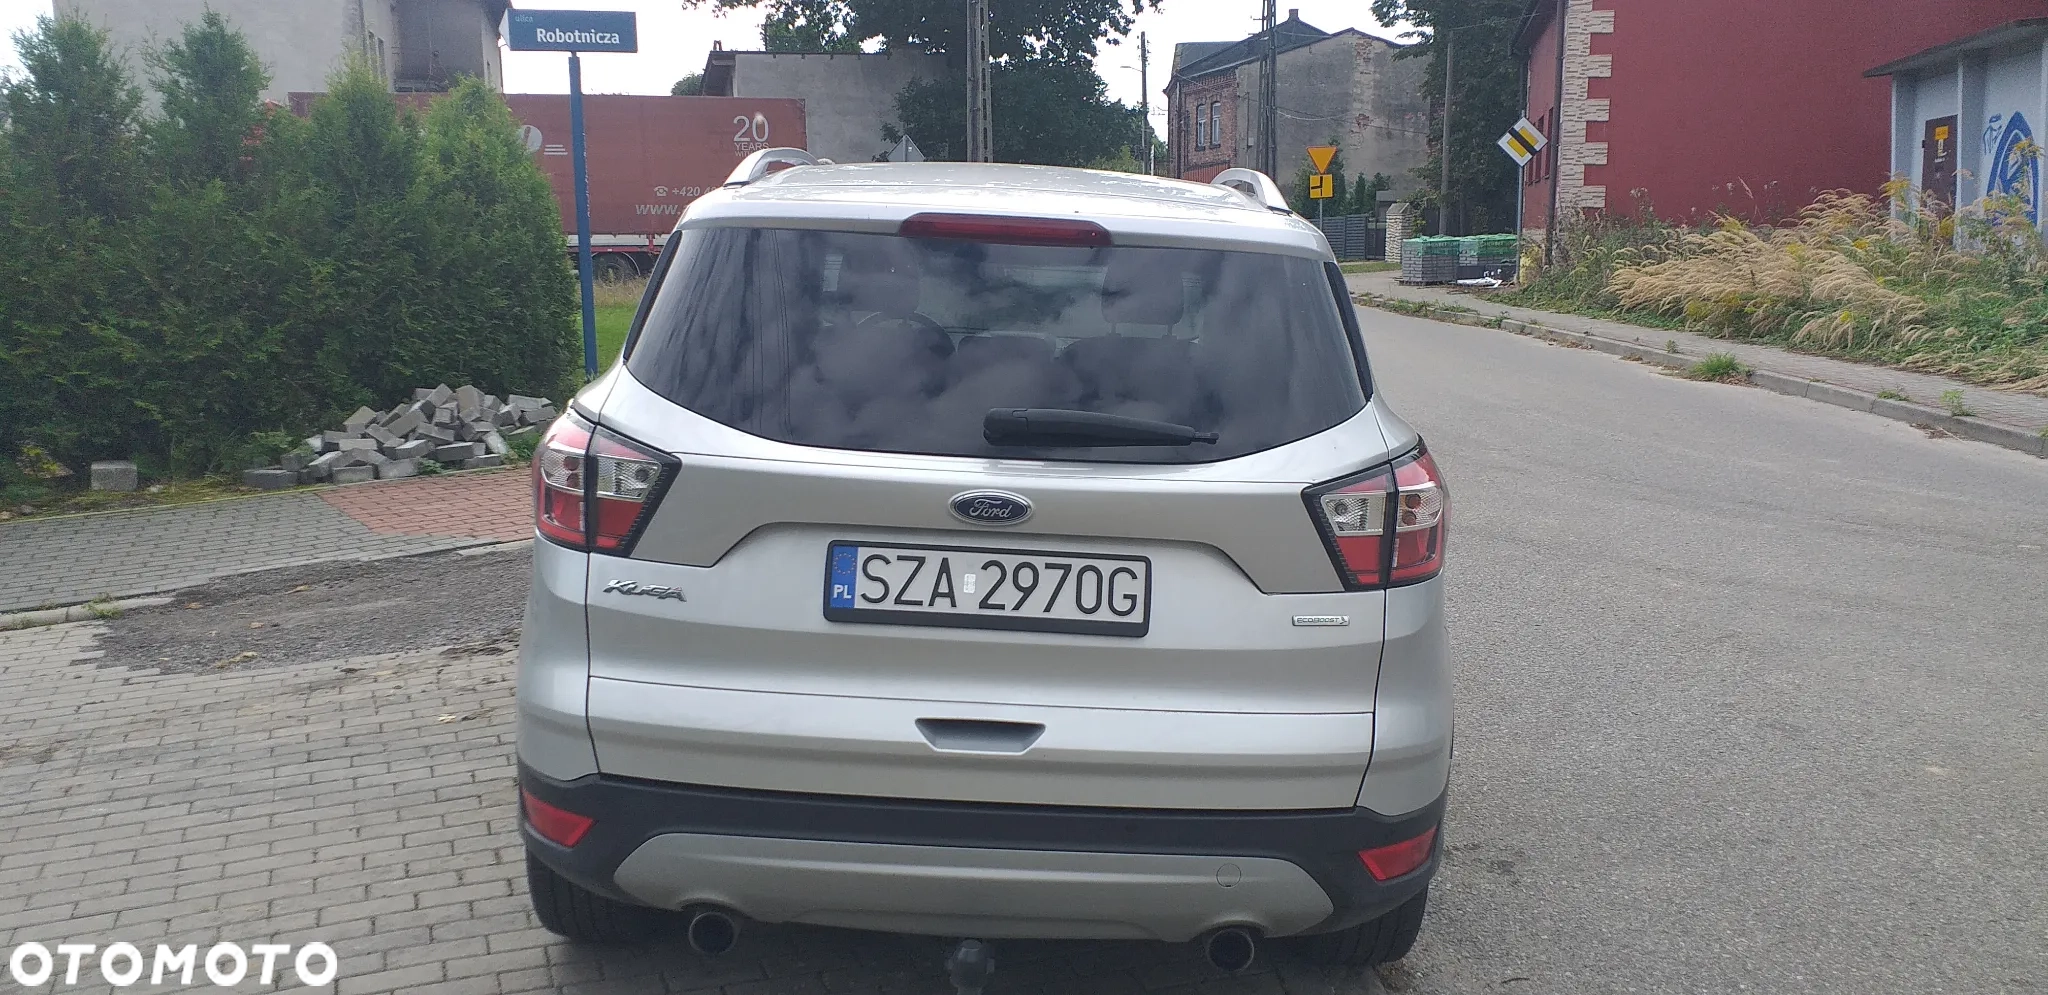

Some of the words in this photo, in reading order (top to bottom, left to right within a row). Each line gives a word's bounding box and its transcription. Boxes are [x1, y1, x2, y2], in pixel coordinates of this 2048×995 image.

[515, 14, 533, 22] ulica
[536, 28, 620, 44] Robotnicza
[733, 115, 769, 142] 20
[734, 142, 769, 151] YEARS
[672, 186, 700, 197] +420
[969, 499, 1012, 517] Ford
[833, 584, 852, 599] PL
[860, 553, 957, 608] SZA
[978, 559, 1138, 617] 2970G
